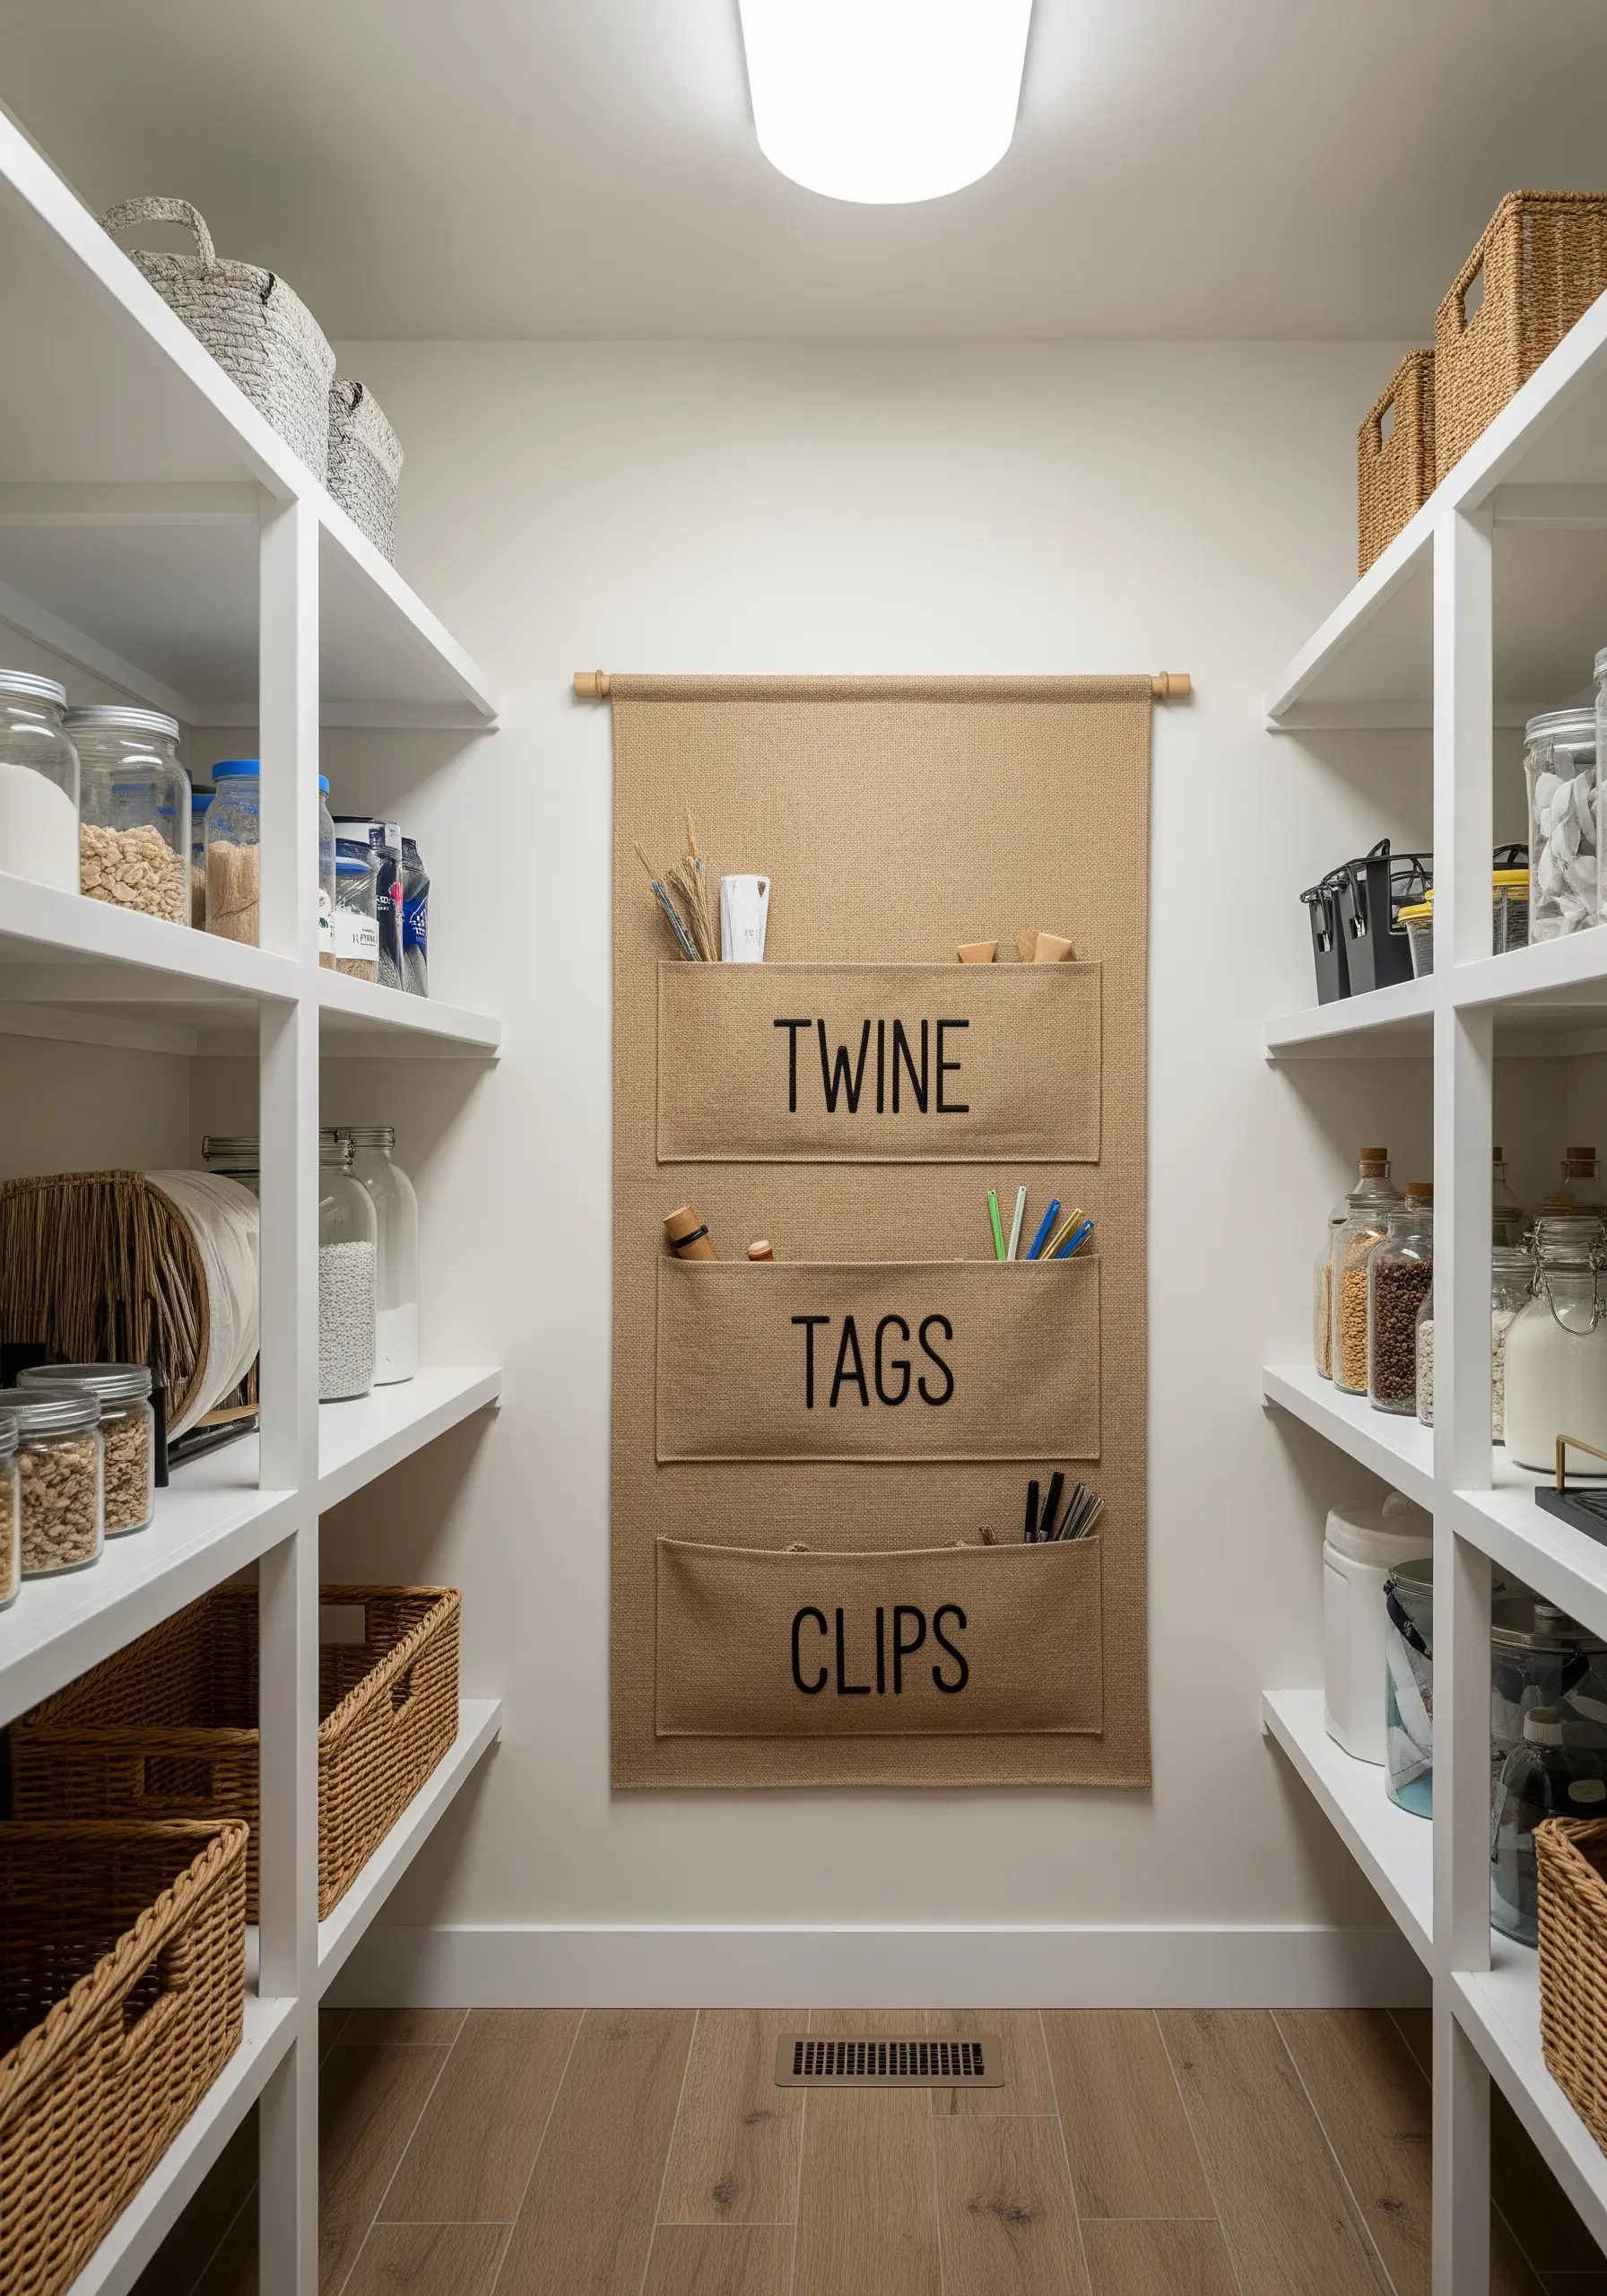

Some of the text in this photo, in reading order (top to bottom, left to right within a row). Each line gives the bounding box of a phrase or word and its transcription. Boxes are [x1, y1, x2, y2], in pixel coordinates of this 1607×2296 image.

[773, 1019, 969, 1114] TWINE
[791, 1314, 955, 1409] TAGS
[791, 1604, 969, 1695] CLIPS
